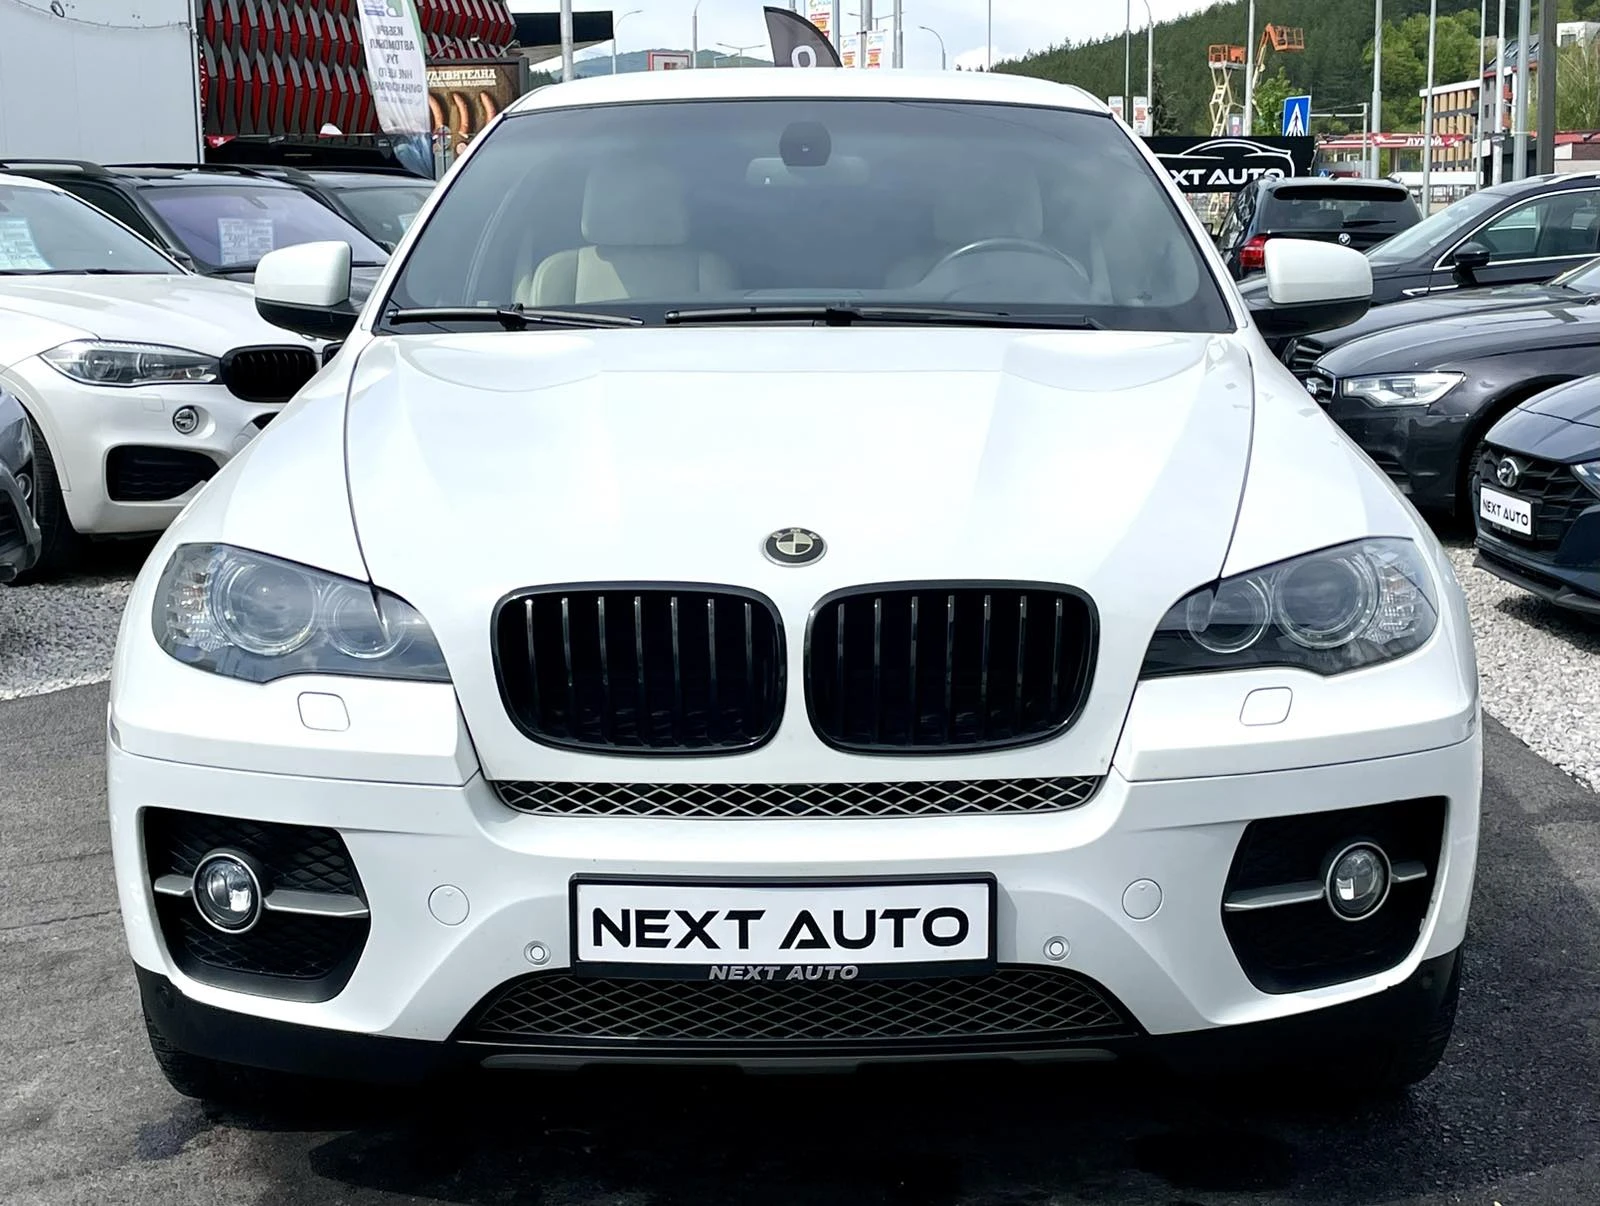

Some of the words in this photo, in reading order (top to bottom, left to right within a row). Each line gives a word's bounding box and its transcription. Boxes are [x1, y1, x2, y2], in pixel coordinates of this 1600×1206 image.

[1169, 169, 1207, 186] XT
[1482, 499, 1502, 518] NEXT
[1503, 508, 1529, 527] AUTO
[592, 907, 766, 950] NEXT
[778, 906, 970, 950] AUTO
[709, 965, 779, 981] NEXT
[784, 965, 859, 981] AUTO
